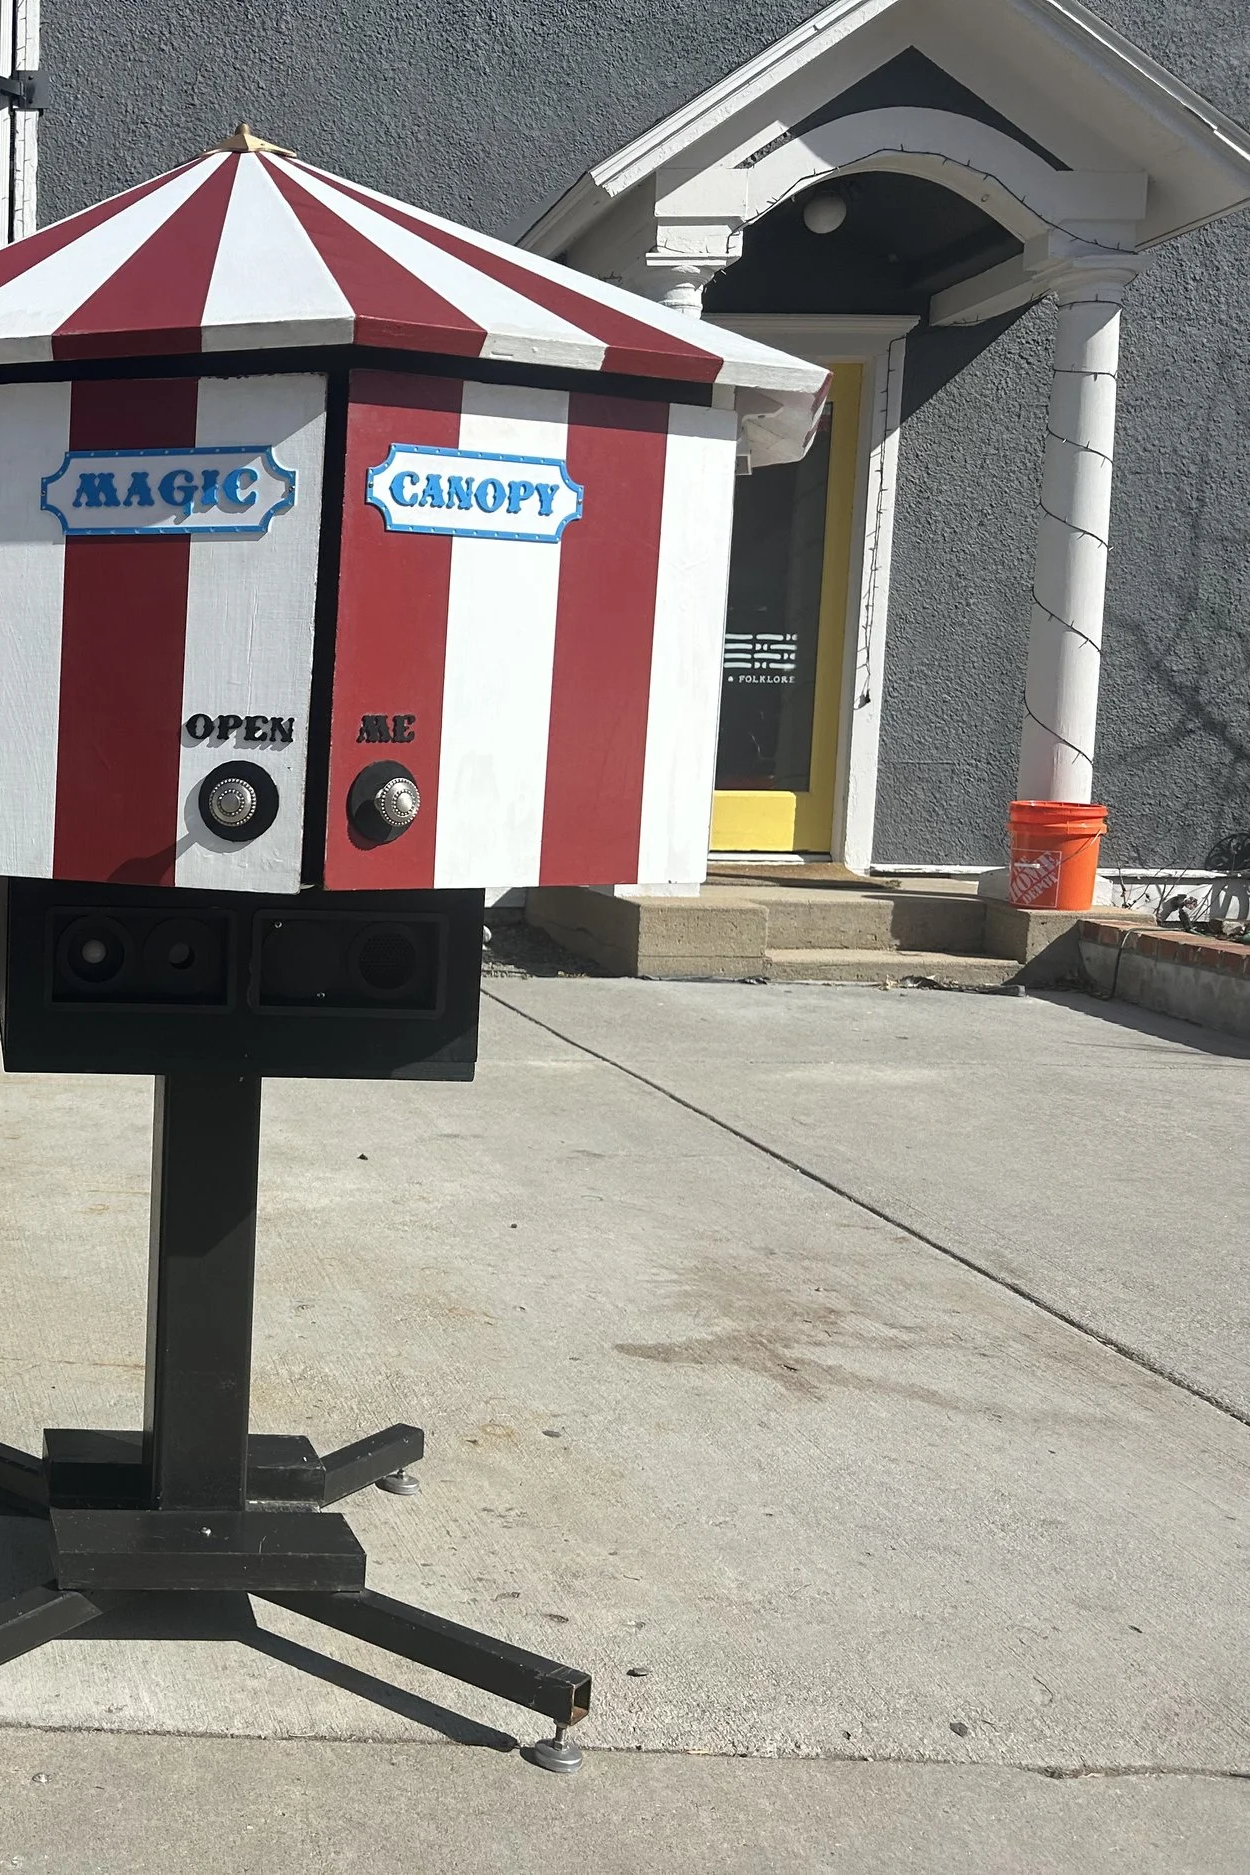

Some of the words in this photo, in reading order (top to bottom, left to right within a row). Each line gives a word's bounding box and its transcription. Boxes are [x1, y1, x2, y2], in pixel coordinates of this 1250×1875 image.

[72, 467, 259, 517] MAGIC
[389, 470, 560, 517] CANOPY
[738, 675, 796, 684] FOLKLORE
[186, 713, 295, 744] OPEN
[357, 713, 416, 744] ME
[1022, 871, 1059, 904] DEPOT
